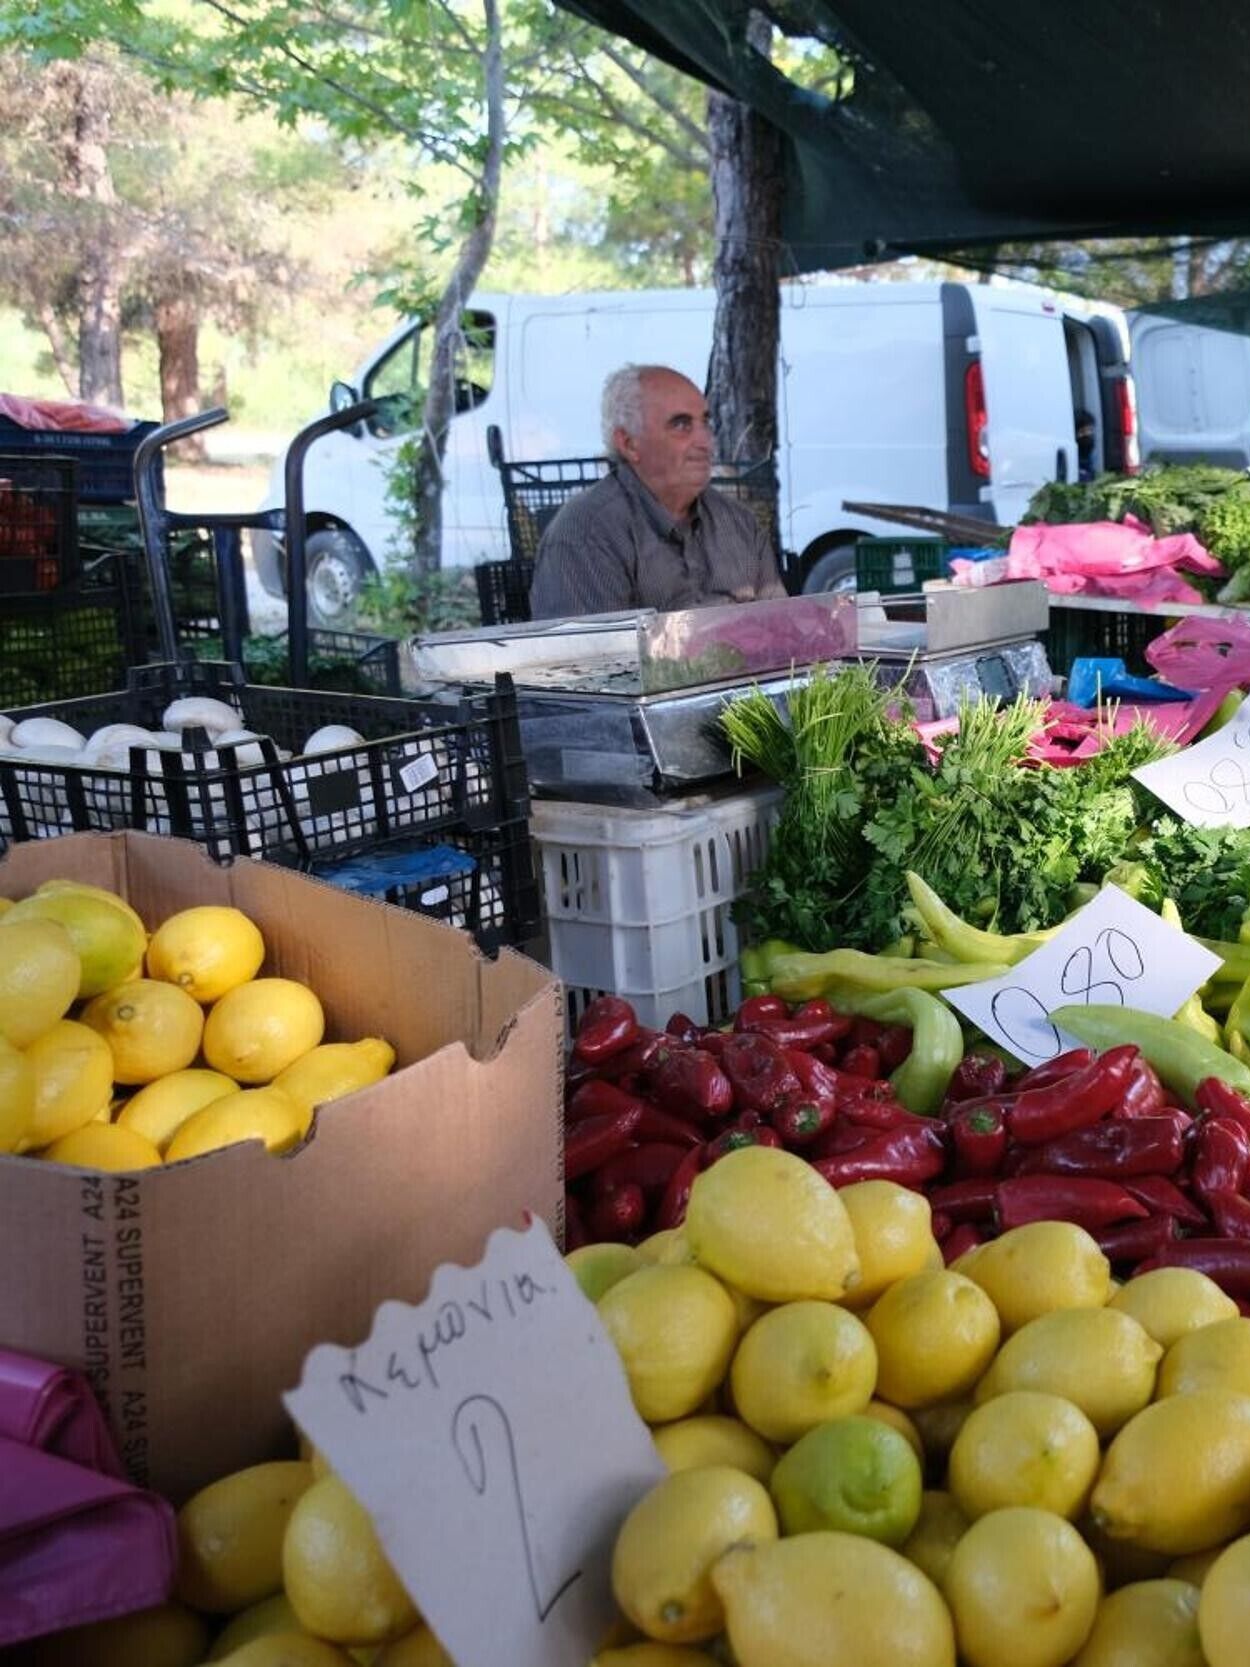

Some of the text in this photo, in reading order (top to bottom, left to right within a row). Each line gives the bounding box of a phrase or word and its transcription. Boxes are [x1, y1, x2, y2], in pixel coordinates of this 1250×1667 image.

[80, 1176, 105, 1221] A24
[111, 1176, 141, 1221] A24
[81, 1233, 111, 1382] SUPERVENT
[116, 1228, 146, 1371] SUPERVENT
[120, 1391, 148, 1432] A24
